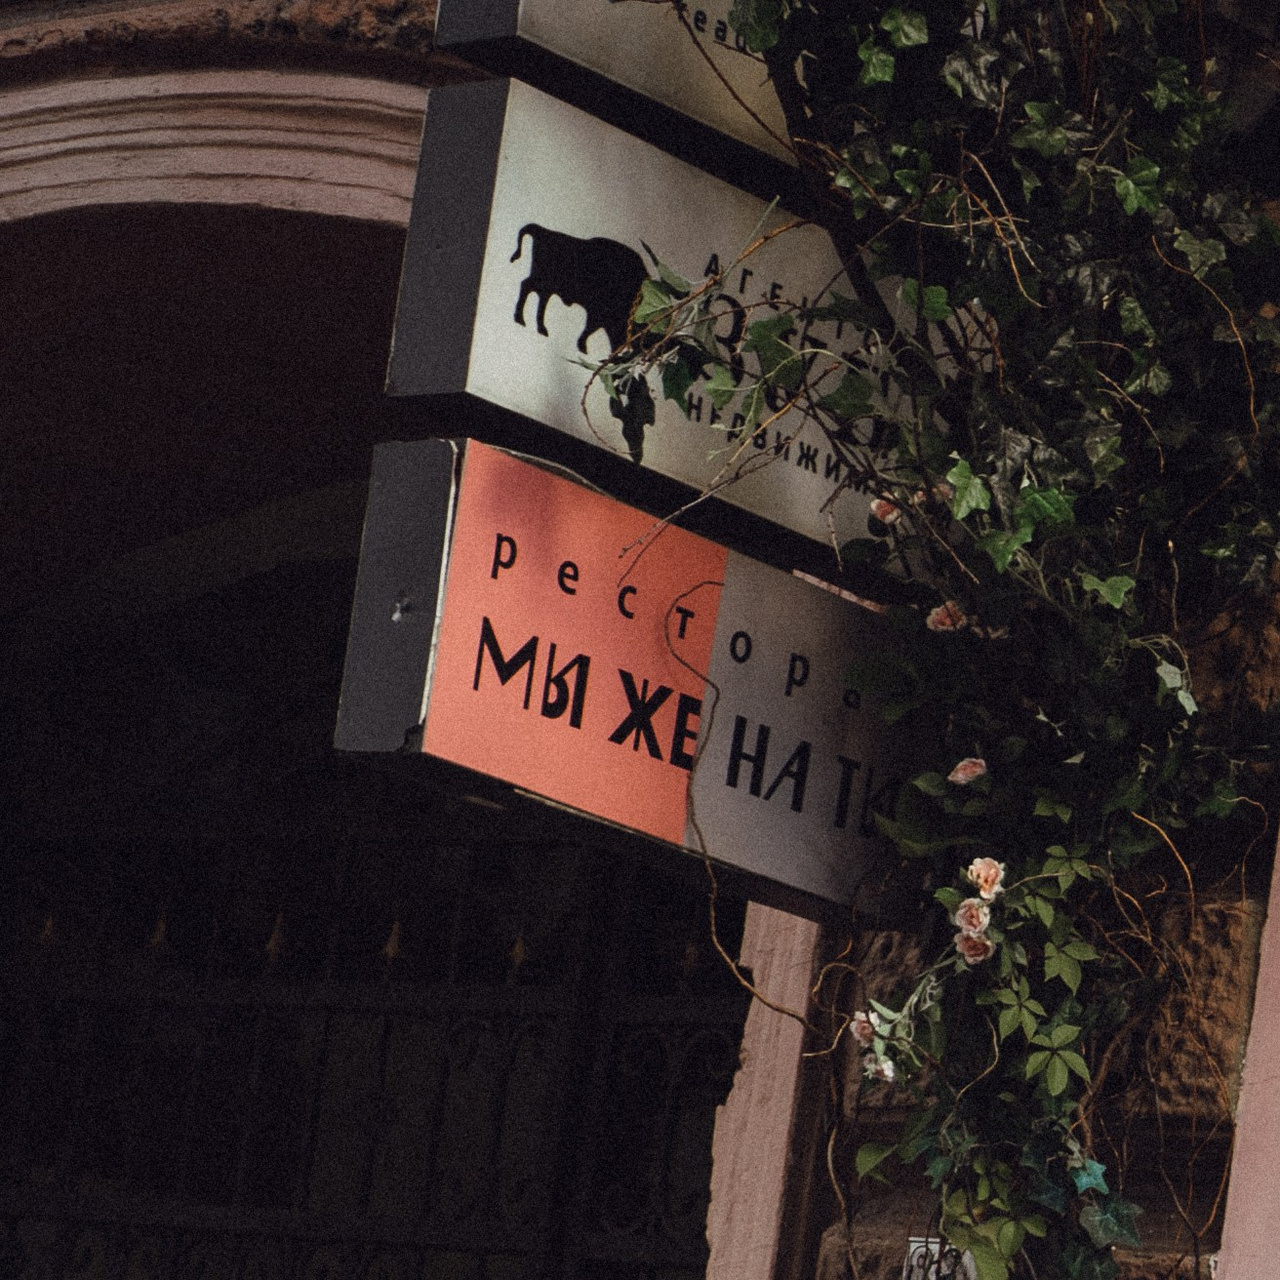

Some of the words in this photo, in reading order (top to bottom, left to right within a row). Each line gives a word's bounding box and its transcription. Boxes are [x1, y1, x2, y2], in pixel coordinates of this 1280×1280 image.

[473, 616, 591, 729] МЫ
[608, 668, 703, 771] ЖЕ
[726, 715, 812, 813] НА
